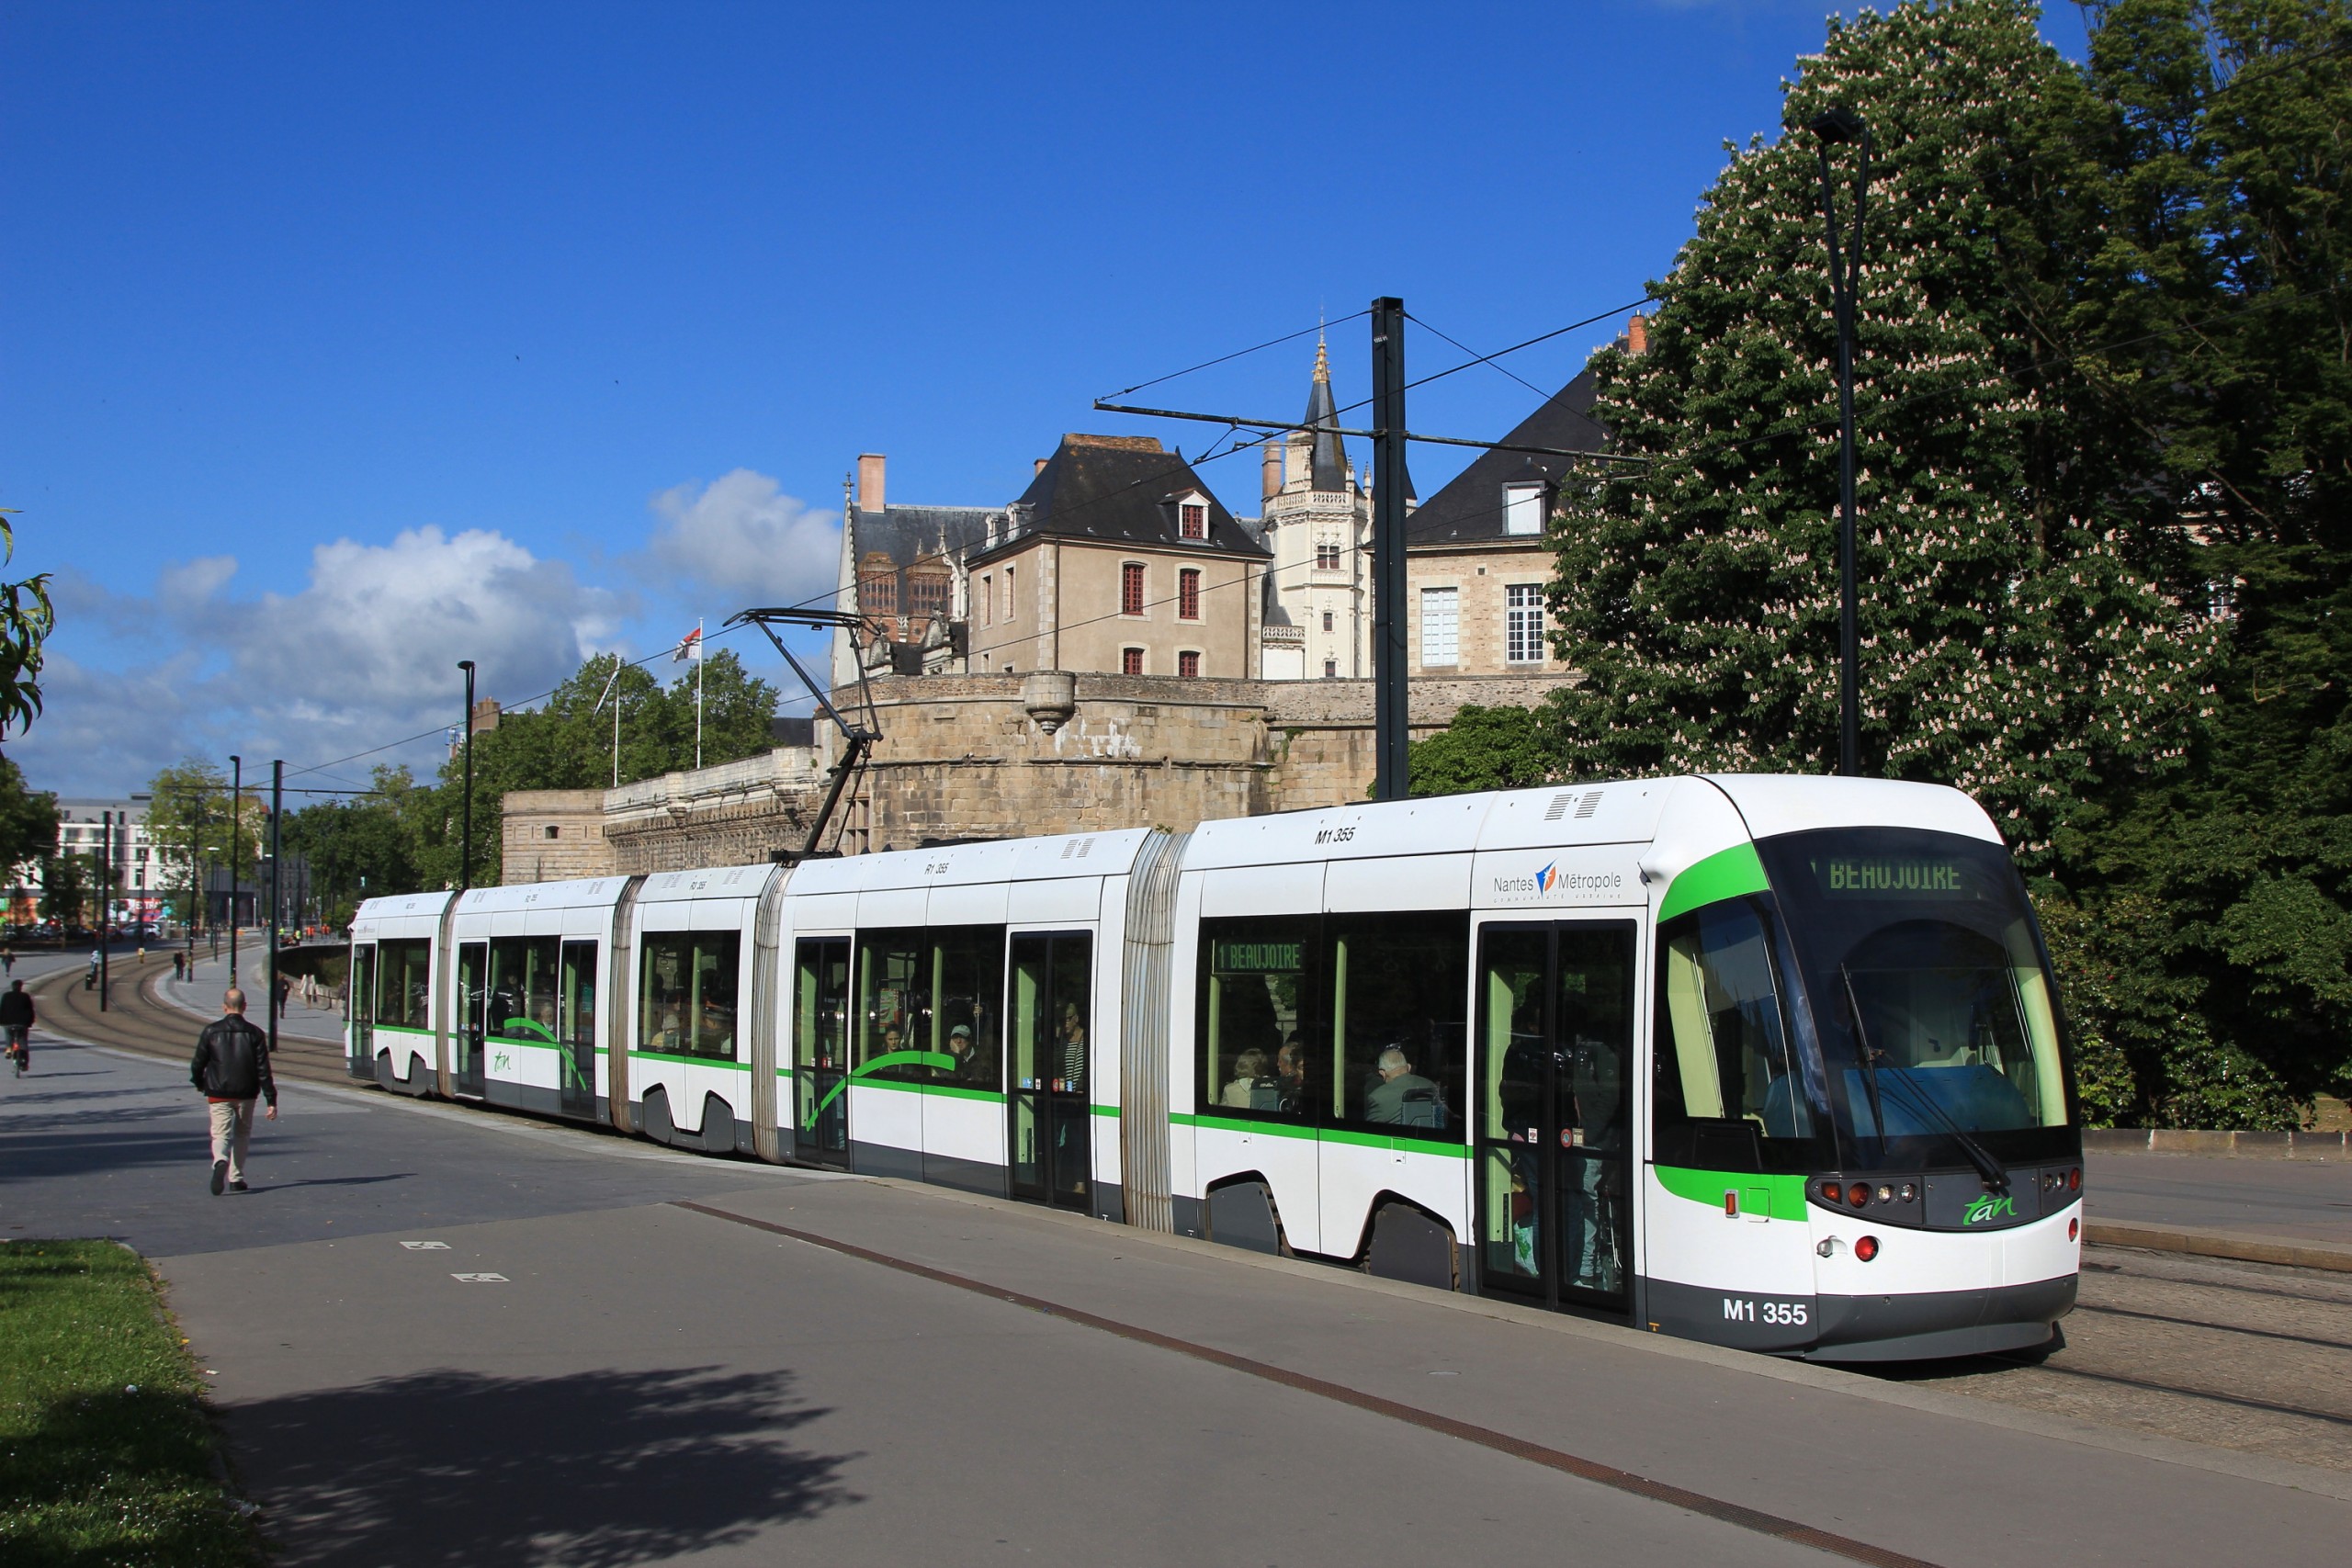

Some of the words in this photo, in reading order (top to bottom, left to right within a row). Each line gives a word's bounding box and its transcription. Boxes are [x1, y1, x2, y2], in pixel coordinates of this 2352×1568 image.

[1315, 829, 1333, 844] M1
[1333, 827, 1356, 842] 355
[935, 863, 949, 874] 355
[1494, 876, 1533, 892] Nantes
[1558, 872, 1622, 891] Métropole
[1219, 944, 1225, 968] 1
[1231, 943, 1301, 969] BEAUJOIRE
[1962, 1194, 2018, 1225] tan
[1724, 1298, 1755, 1322] M1
[1763, 1302, 1808, 1325] 355
